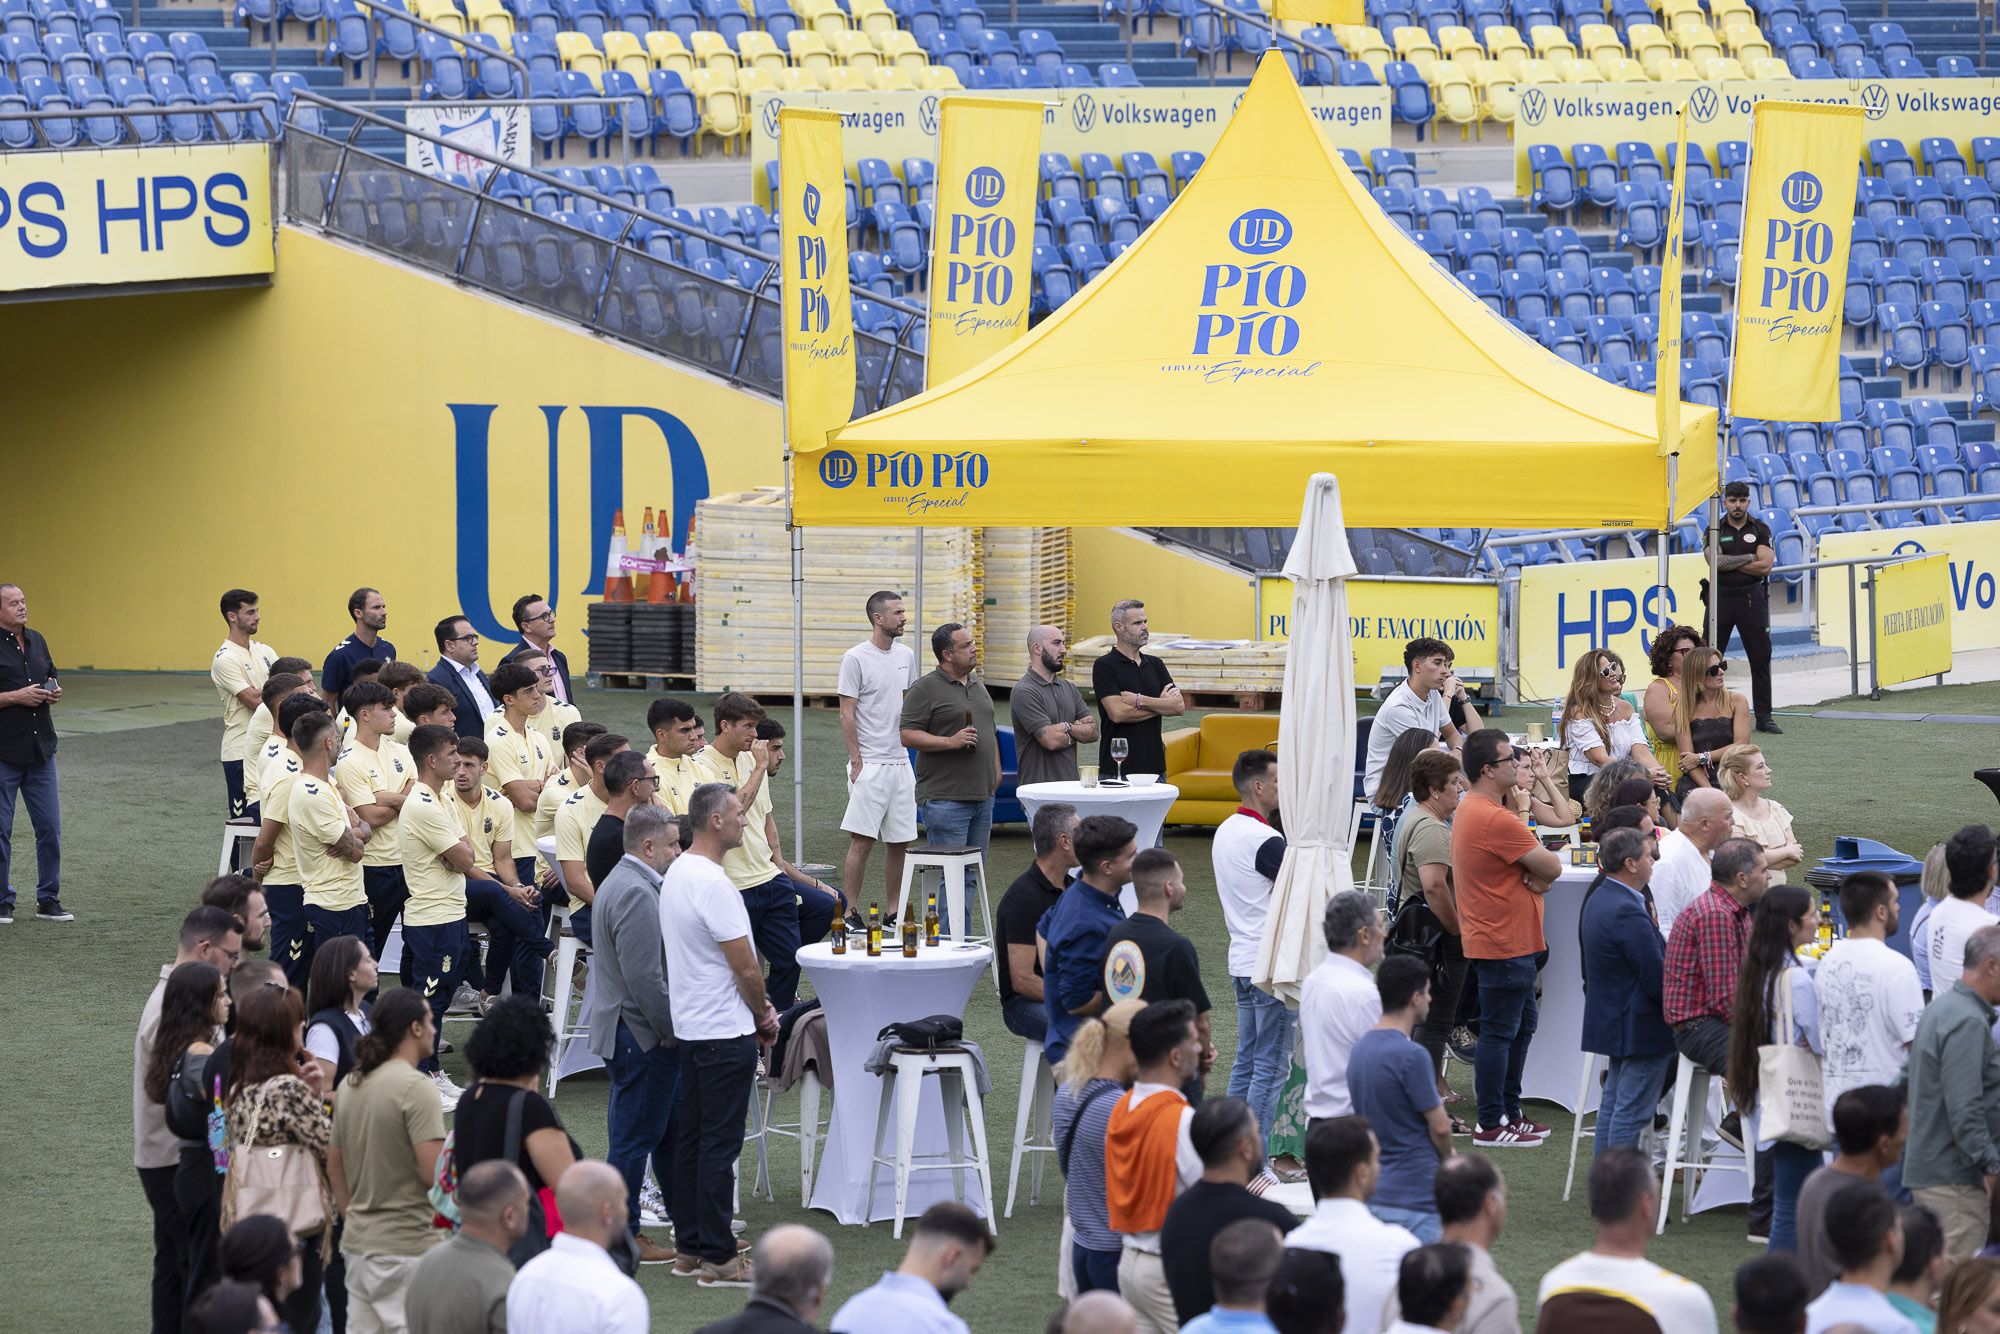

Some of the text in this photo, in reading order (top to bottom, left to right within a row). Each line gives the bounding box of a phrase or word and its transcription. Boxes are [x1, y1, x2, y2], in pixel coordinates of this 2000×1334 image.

[1102, 103, 1217, 128] Volkswagen
[1310, 106, 1382, 126] swagen
[1553, 97, 1673, 121] Volkswagen
[840, 112, 905, 133] wagen
[0, 172, 250, 258] S HPS
[955, 309, 1024, 336] Especial
[1768, 314, 1837, 342] Especial
[1204, 360, 1322, 384] Especial
[906, 491, 970, 516] Especial
[1349, 613, 1486, 641] DE EVACUACIÓN
[1558, 584, 1677, 669] HPS
[1884, 611, 1905, 637] PUERTA
[1906, 609, 1914, 631] DE
